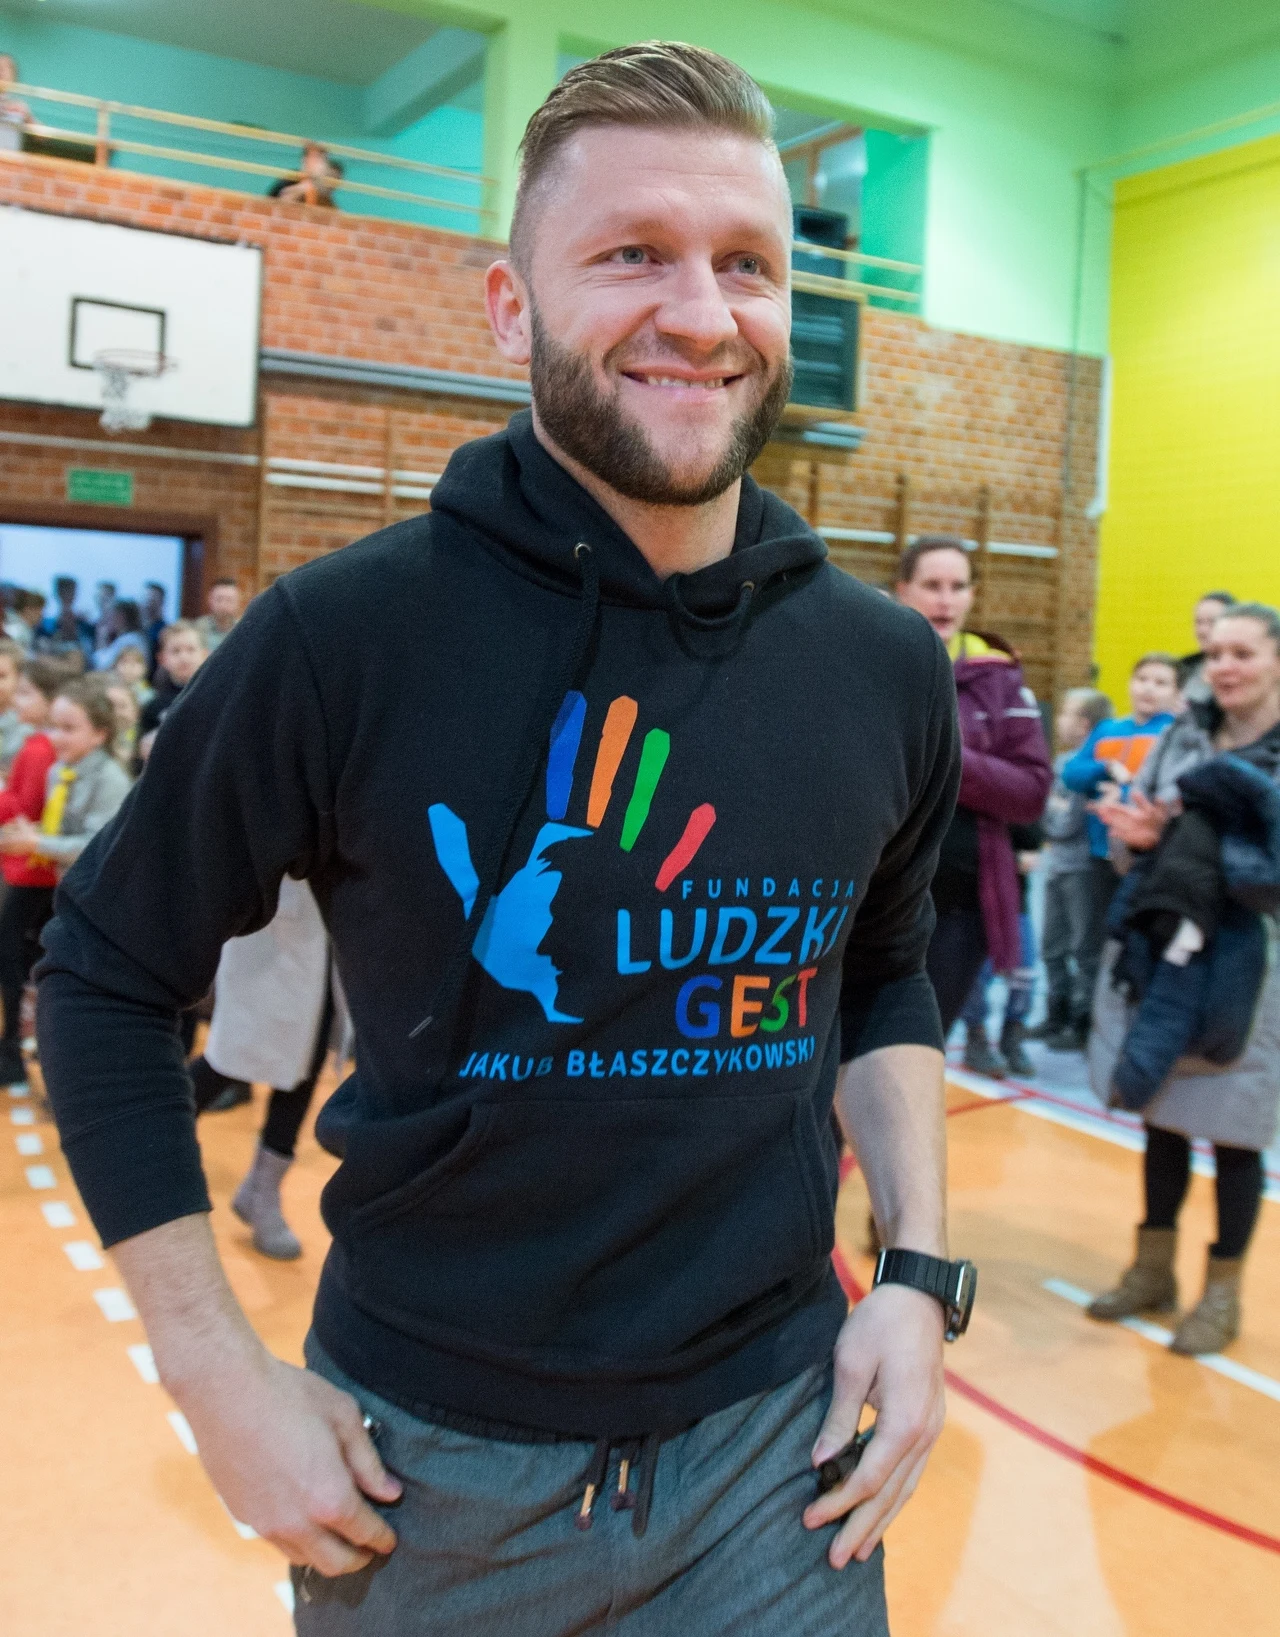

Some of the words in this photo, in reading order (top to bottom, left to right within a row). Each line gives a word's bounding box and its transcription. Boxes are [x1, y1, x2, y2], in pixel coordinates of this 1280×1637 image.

[681, 877, 855, 899] FUNDACJA
[616, 905, 848, 976] LUDZKI
[675, 968, 818, 1039] GEST
[458, 1050, 552, 1082] JAKUB
[566, 1035, 816, 1078] BŁASZCZYKOWSKI
